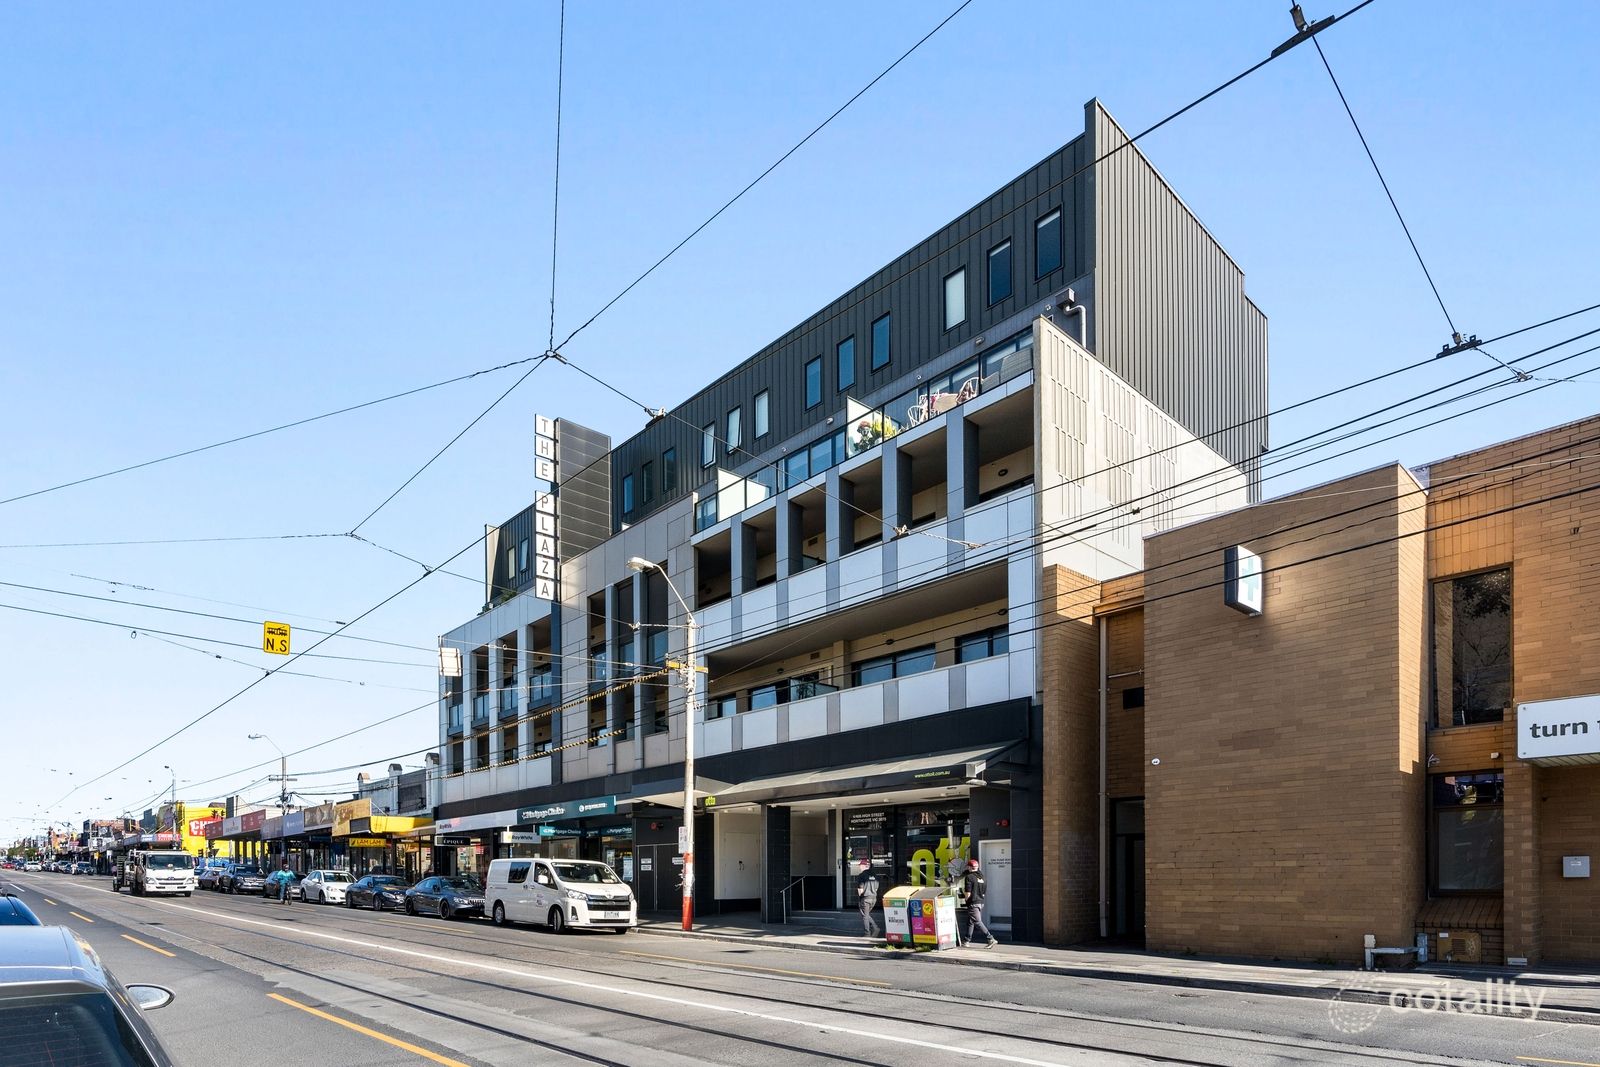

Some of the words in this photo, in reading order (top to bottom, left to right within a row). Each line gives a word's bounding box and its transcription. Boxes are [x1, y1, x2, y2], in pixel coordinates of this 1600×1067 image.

[541, 418, 549, 477] THE
[541, 495, 550, 597] PLAZA
[1529, 720, 1589, 739] turn
